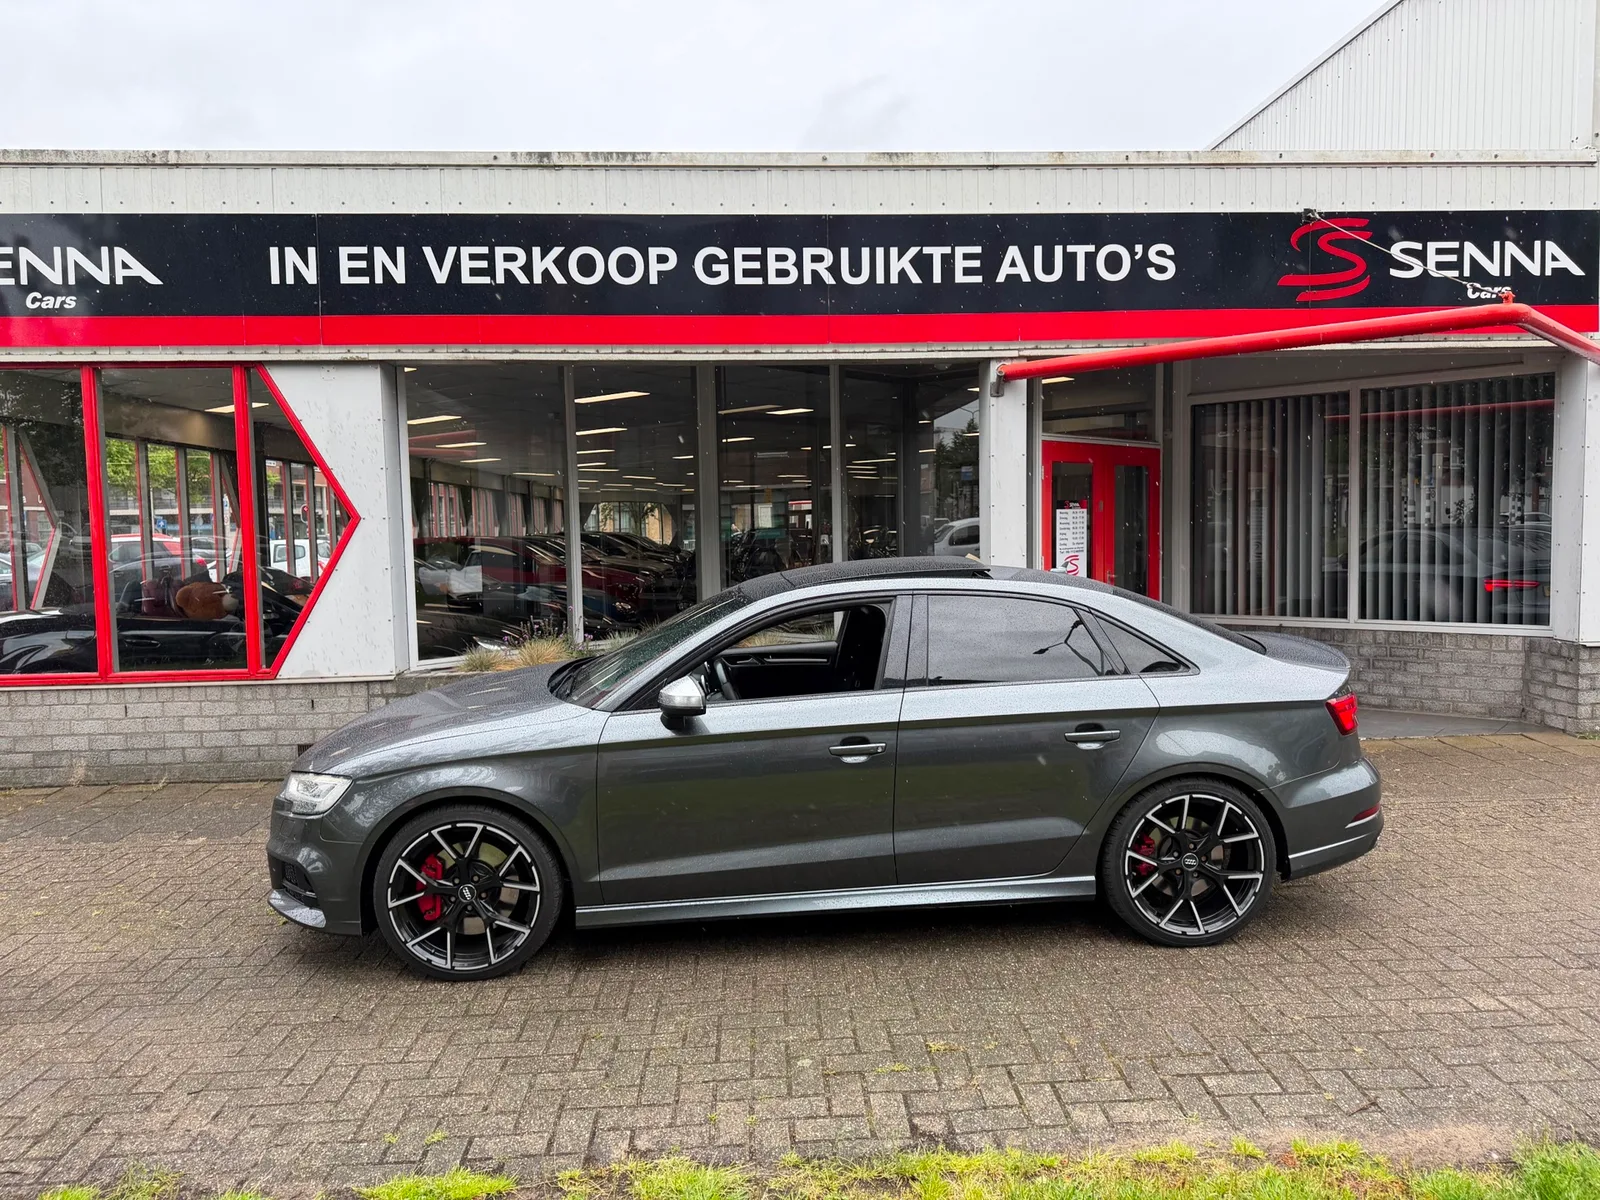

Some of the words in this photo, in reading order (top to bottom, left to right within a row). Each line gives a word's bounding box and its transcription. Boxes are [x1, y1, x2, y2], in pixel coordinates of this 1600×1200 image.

[269, 246, 318, 286] IN
[338, 246, 406, 285] EN
[421, 245, 678, 286] VERKOOP
[691, 245, 984, 287] GEBRUIKTE
[995, 243, 1177, 284] AUTO'S
[1389, 239, 1587, 280] SENNA
[25, 291, 78, 310] Cars
